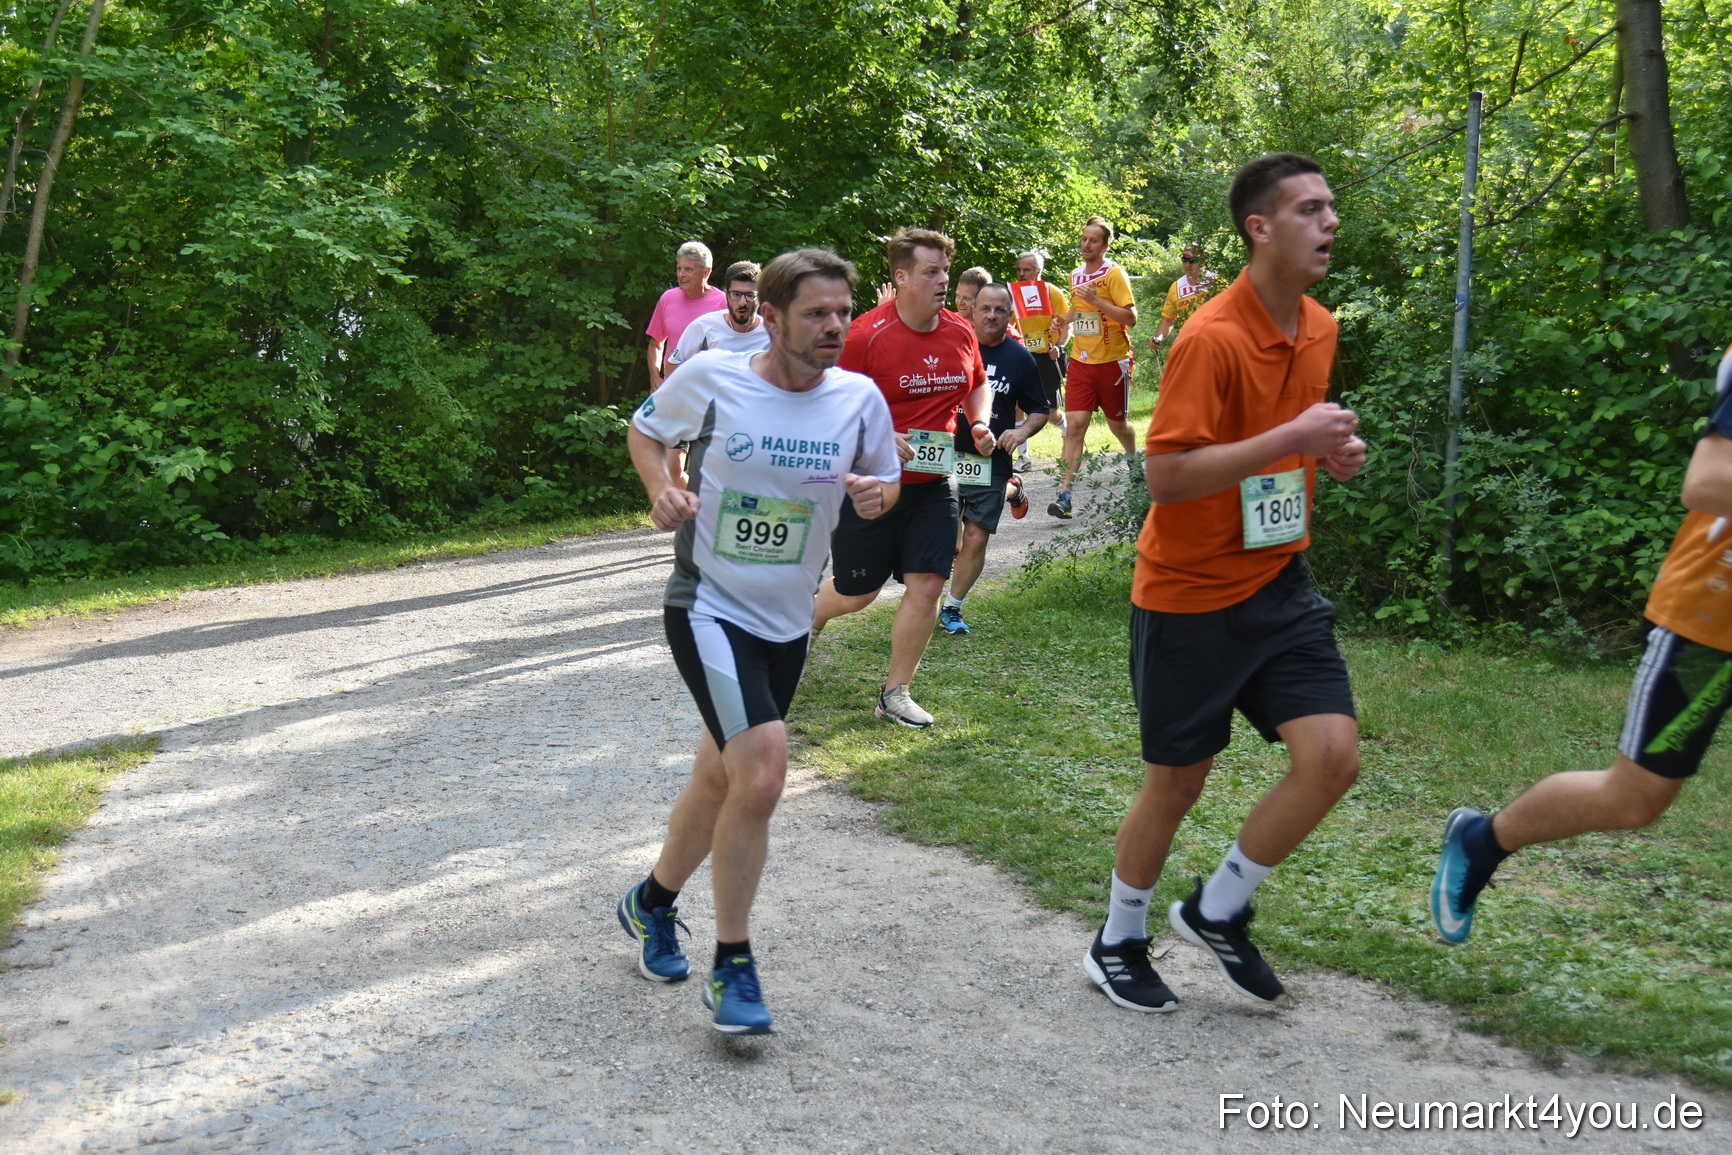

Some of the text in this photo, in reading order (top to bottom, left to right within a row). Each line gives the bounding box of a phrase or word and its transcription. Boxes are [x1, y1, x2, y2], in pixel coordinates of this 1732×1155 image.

[1076, 320, 1095, 330] 1711
[899, 374, 928, 389] Echtes
[909, 385, 958, 395] IMMER FRISCH
[761, 436, 840, 457] HAUBNER
[917, 445, 946, 462] 587
[770, 454, 832, 471] TREPPEN
[956, 462, 982, 476] 390
[1255, 495, 1302, 527] 1803
[735, 518, 788, 547] 999
[752, 545, 785, 554] Christian
